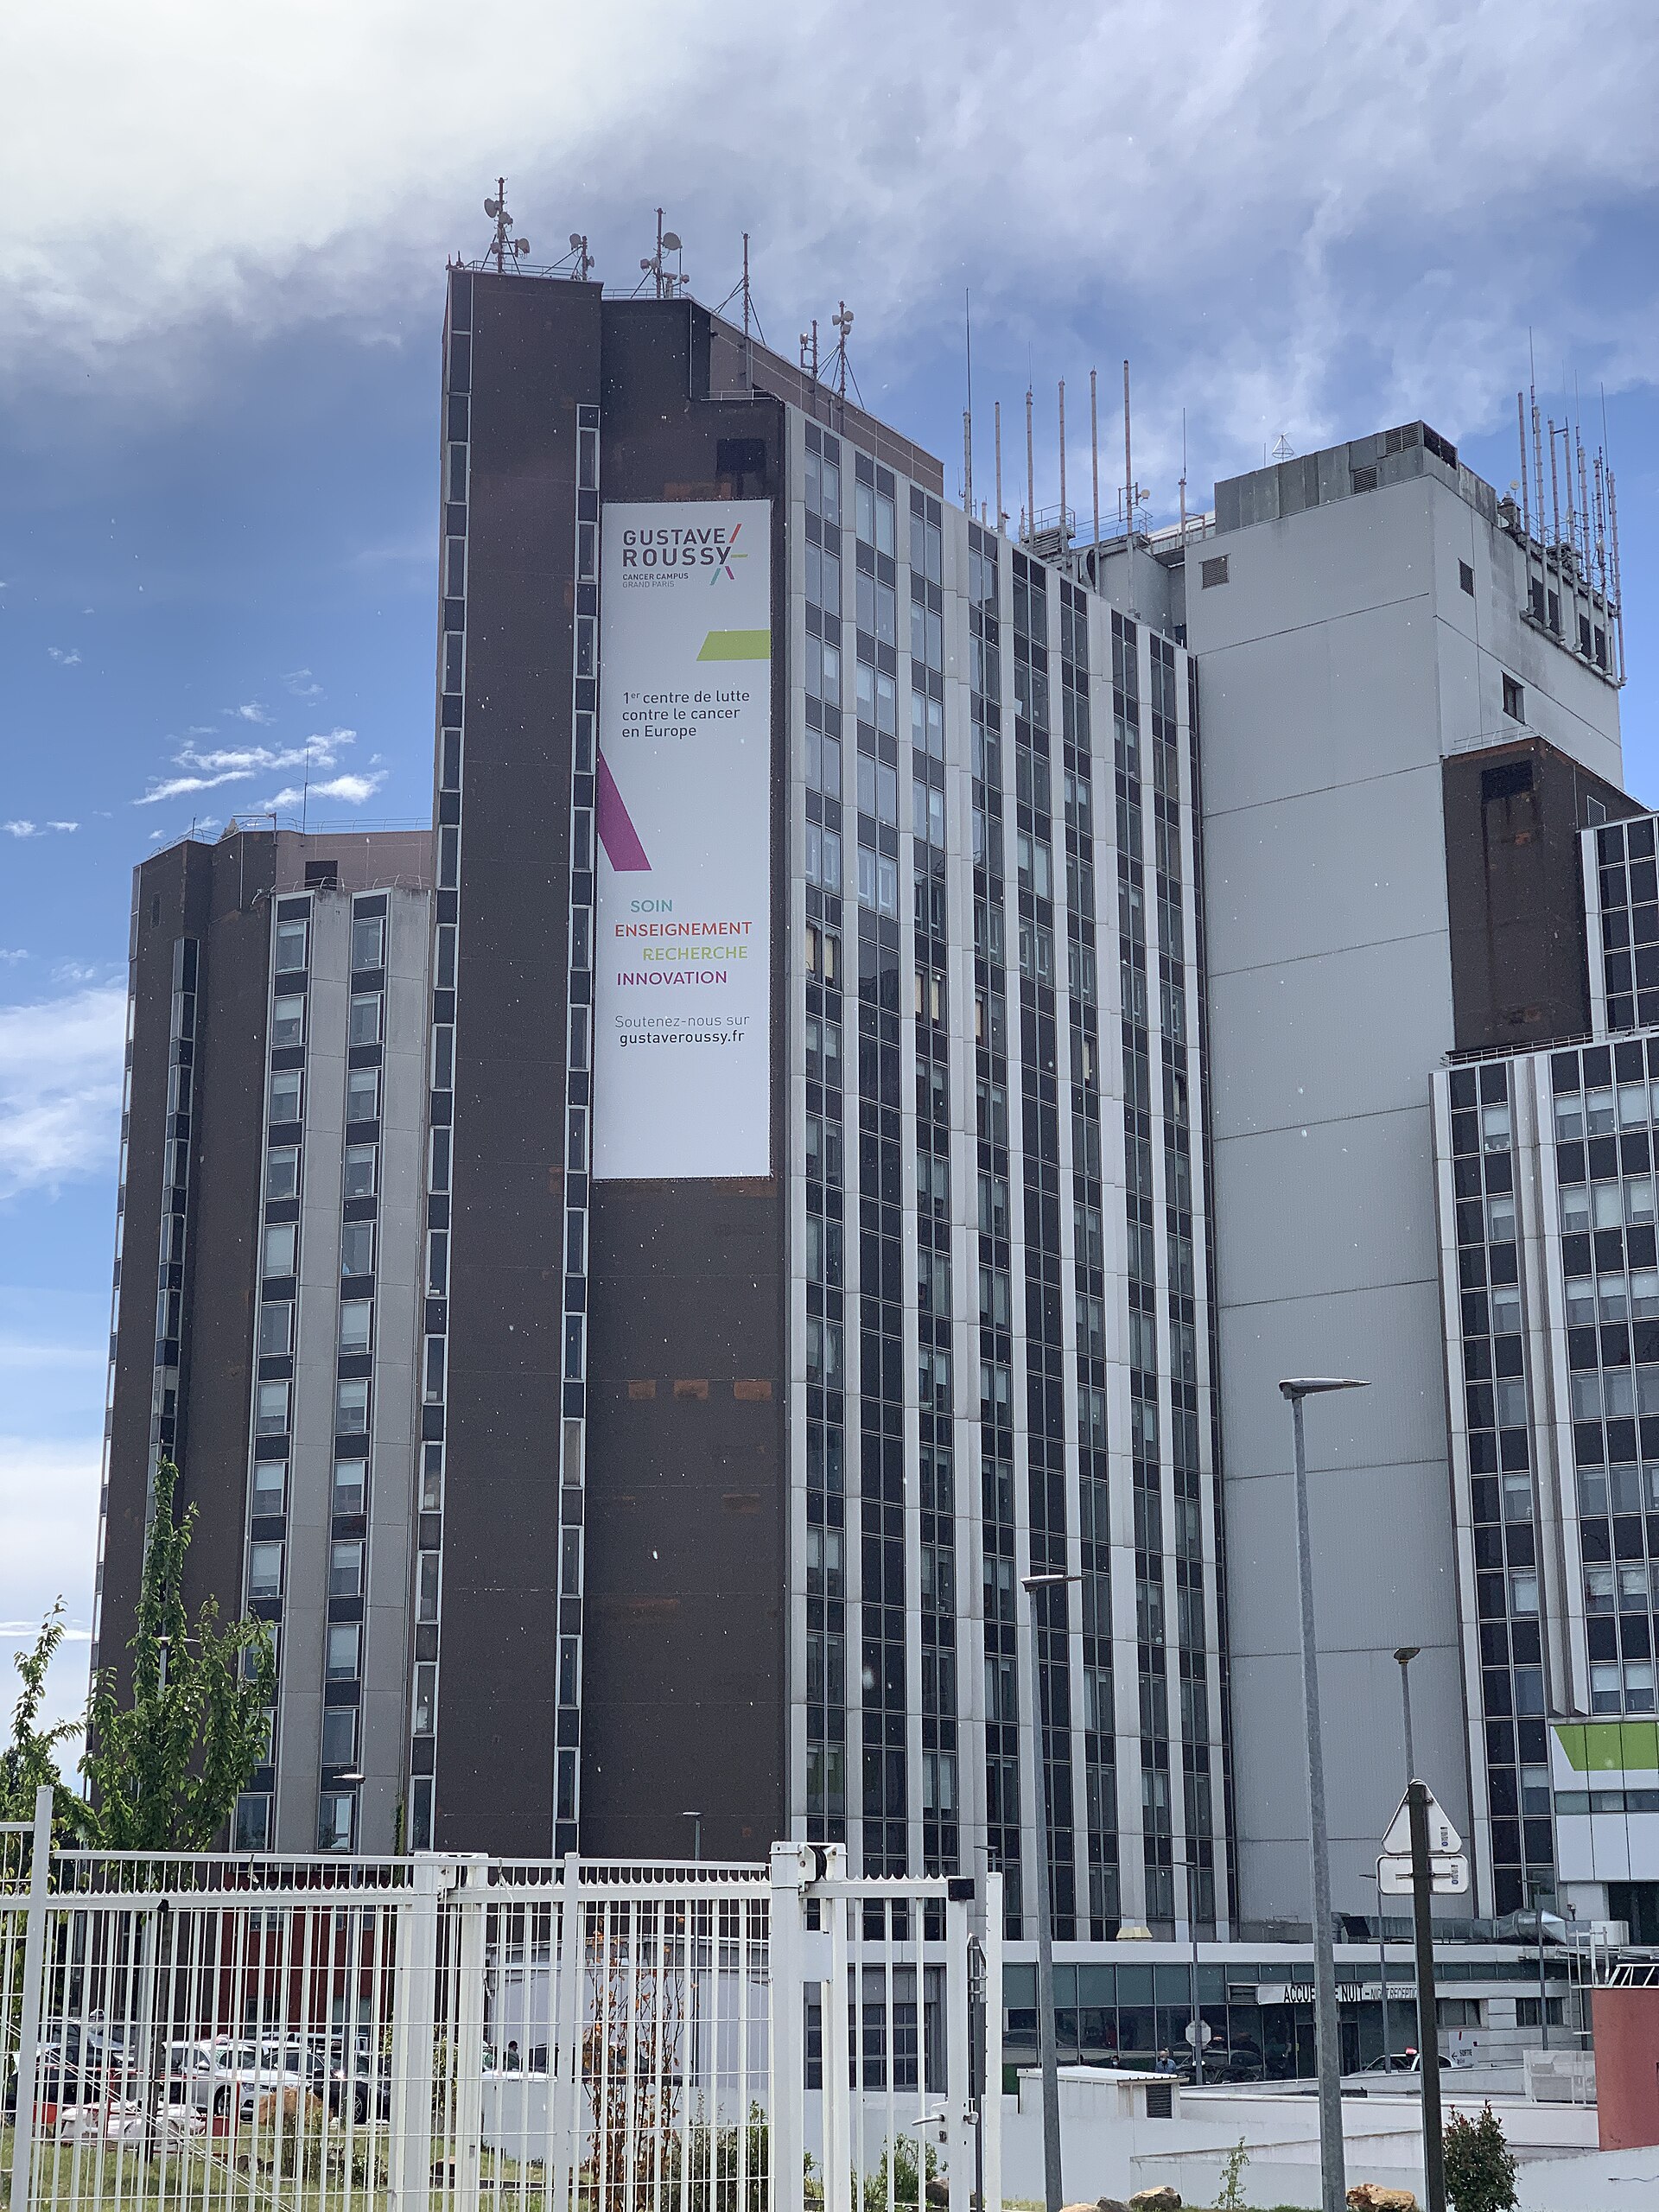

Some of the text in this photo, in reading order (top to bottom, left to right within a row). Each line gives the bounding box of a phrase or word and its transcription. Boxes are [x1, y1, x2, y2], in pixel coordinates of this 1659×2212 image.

[623, 528, 726, 545] GUSTAVE
[622, 546, 732, 567] ROUSSY
[643, 692, 690, 704] centre
[694, 690, 711, 703] de
[716, 690, 750, 702] lutte
[622, 708, 741, 721] contre le cancer
[622, 725, 697, 740] en Europe
[630, 899, 673, 912] SOIN
[615, 921, 753, 937] ENSEIGNEMENT
[643, 945, 748, 961] RECHERCHE
[617, 970, 727, 986] INNOVATION
[615, 1014, 750, 1028] Soutenez-nous sur
[620, 1029, 745, 1047] gustaveroussy.fr
[1284, 1984, 1315, 2002] ACCUE
[1341, 1984, 1363, 2001] NUIT
[1370, 1988, 1389, 2001] NIGT
